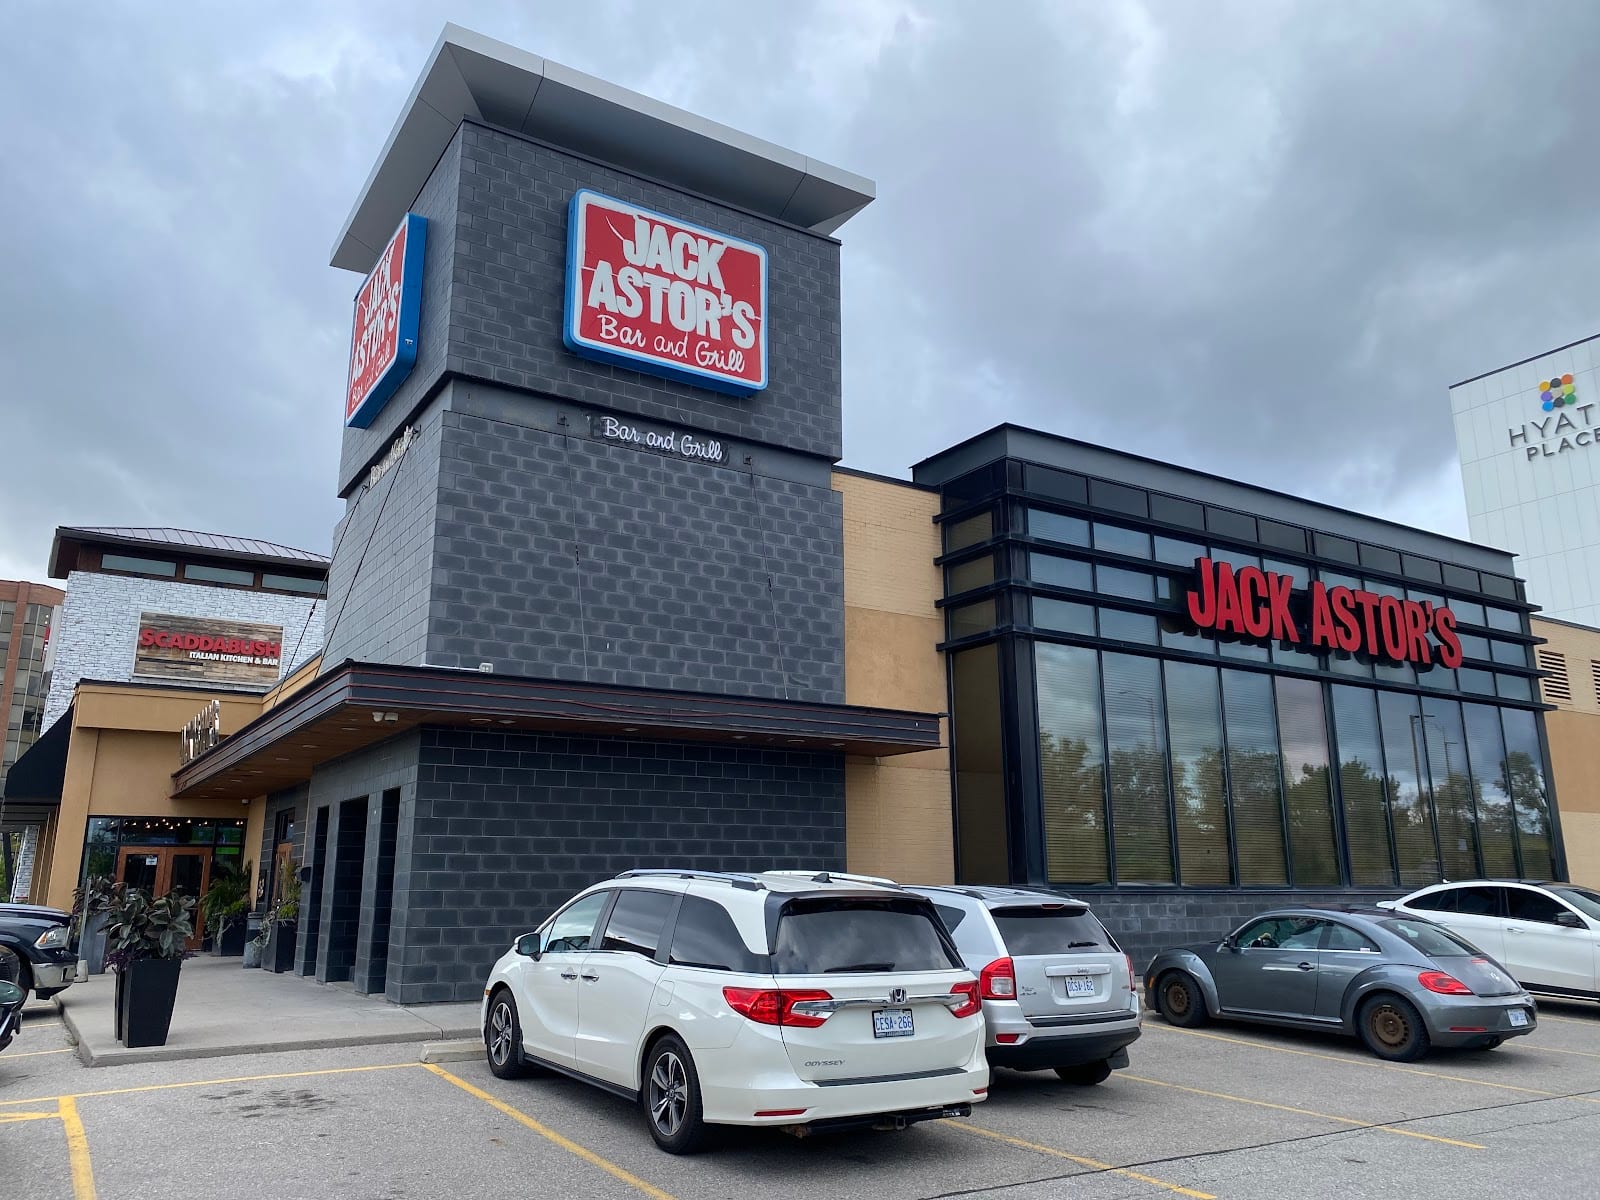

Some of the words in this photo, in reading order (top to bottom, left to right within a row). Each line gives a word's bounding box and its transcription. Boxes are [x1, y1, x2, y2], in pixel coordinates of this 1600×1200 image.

[608, 213, 727, 291] JACK
[587, 260, 756, 349] ASTOR'S
[597, 314, 646, 348] Bar
[654, 332, 688, 359] and
[695, 341, 745, 373] Grill
[601, 416, 641, 442] Bar
[646, 431, 675, 450] and
[680, 435, 723, 460] Grill
[140, 628, 281, 657] SCADDABUSH
[1187, 557, 1300, 642] JACK
[1309, 580, 1463, 669] ASTOR'S
[189, 651, 220, 661] ITALIAN
[220, 653, 254, 664] KITCHEN
[254, 657, 261, 665] &
[262, 658, 279, 666] BAR
